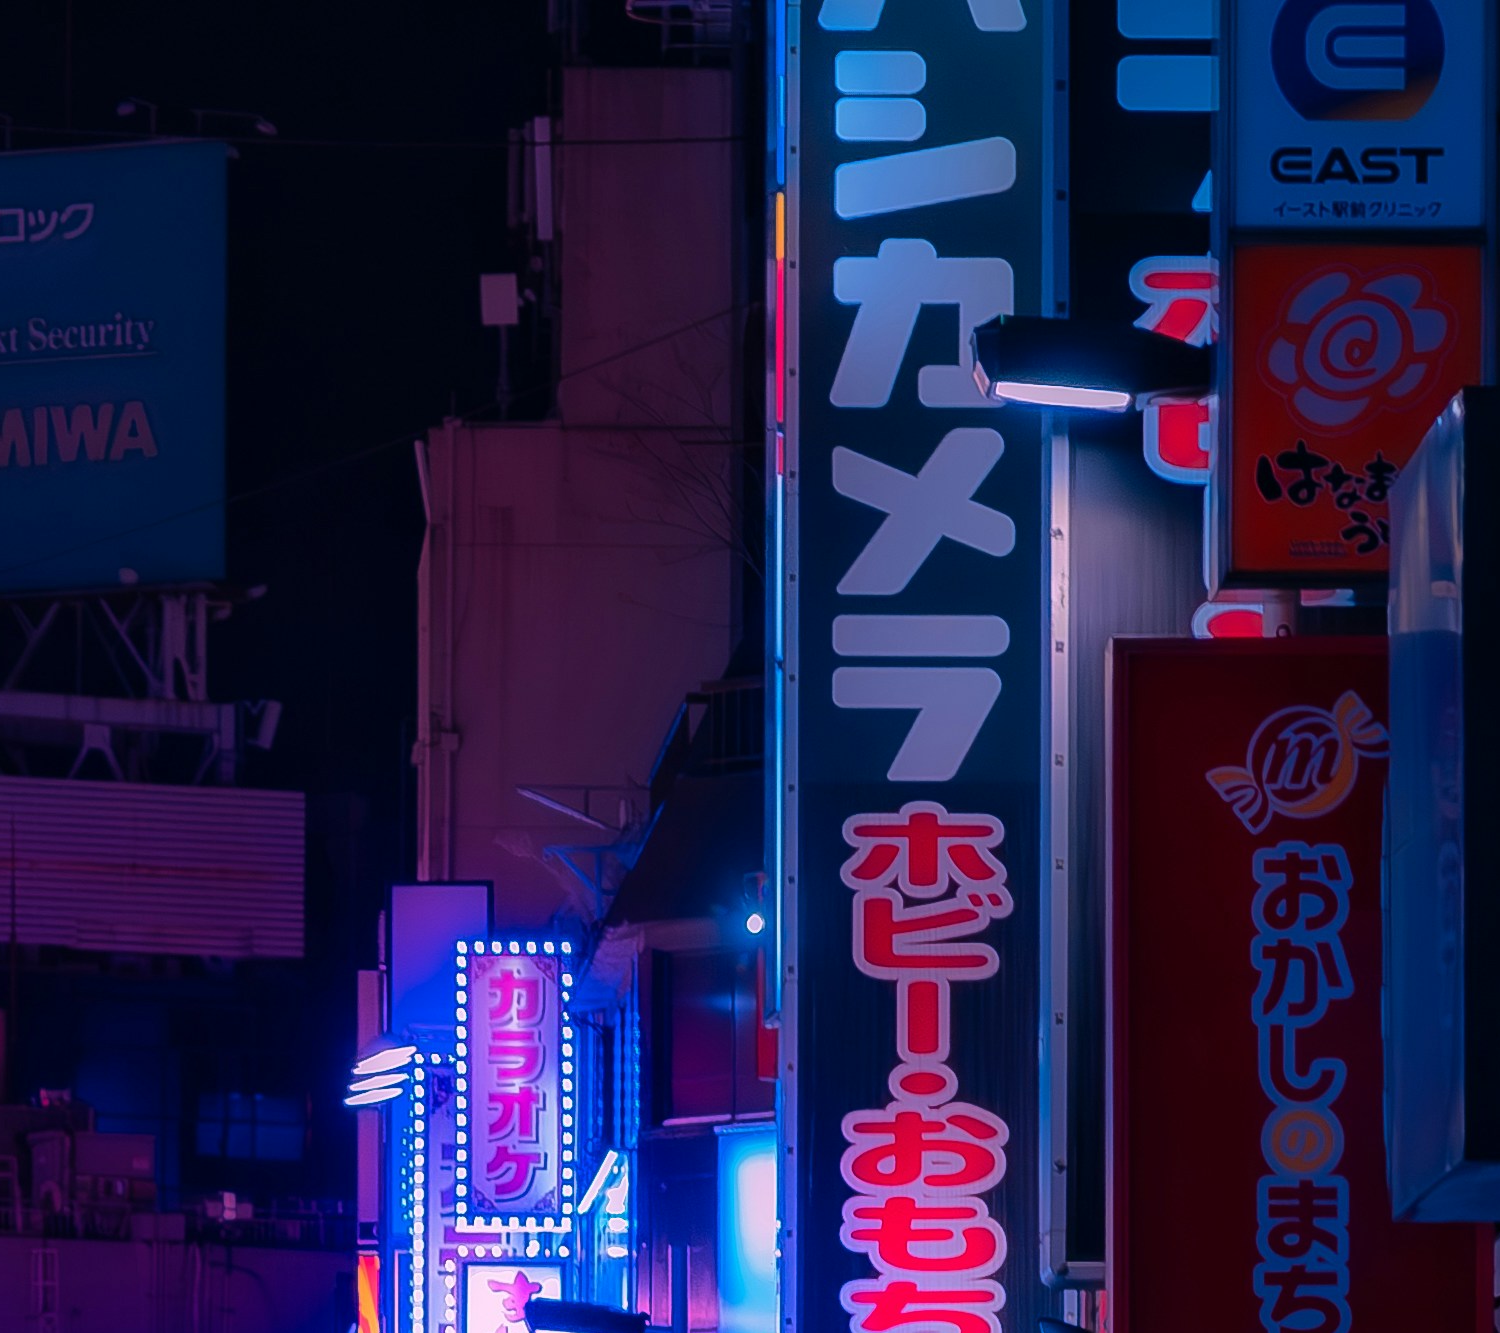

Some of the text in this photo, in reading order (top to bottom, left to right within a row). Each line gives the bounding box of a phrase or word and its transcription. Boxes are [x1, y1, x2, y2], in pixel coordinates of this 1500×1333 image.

[1270, 147, 1445, 185] EAST
[1272, 201, 1442, 219] イースト駅前クリニック
[27, 312, 155, 351] Security
[818, 0, 1027, 781] シカメラ
[486, 969, 547, 1199] カラオケ
